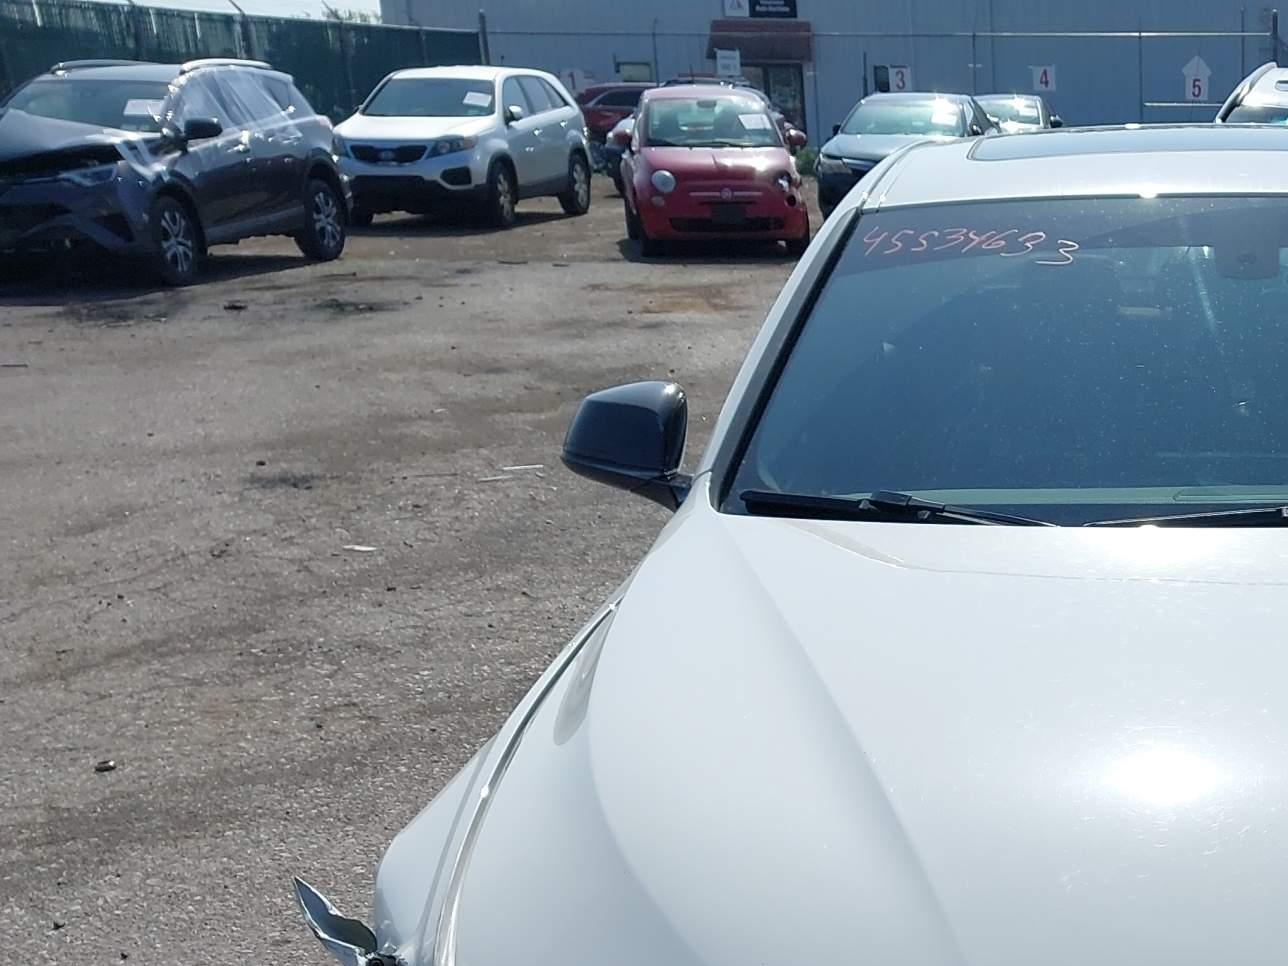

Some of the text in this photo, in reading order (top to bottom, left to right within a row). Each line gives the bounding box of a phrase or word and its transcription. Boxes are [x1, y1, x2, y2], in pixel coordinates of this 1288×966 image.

[895, 70, 906, 89] 3
[1039, 70, 1049, 88] 4
[1191, 78, 1201, 98] 5
[863, 226, 1079, 265] 45534633
